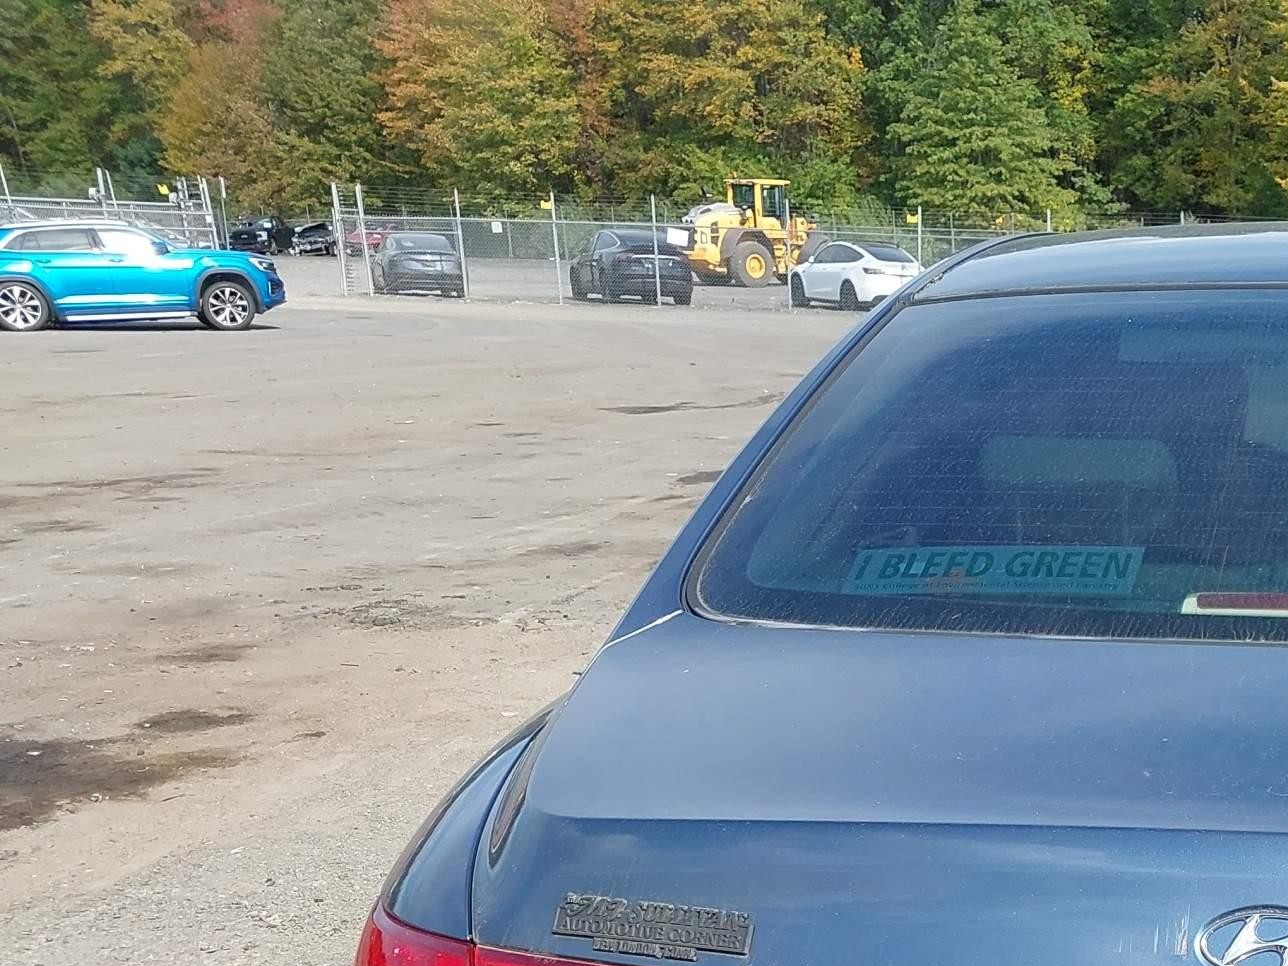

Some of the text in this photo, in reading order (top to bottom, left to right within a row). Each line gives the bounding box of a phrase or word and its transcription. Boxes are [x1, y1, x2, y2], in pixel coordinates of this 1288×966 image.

[854, 551, 1134, 581] I BLEED GREEN
[560, 916, 744, 950] AUTOMOTIVE CORNER
